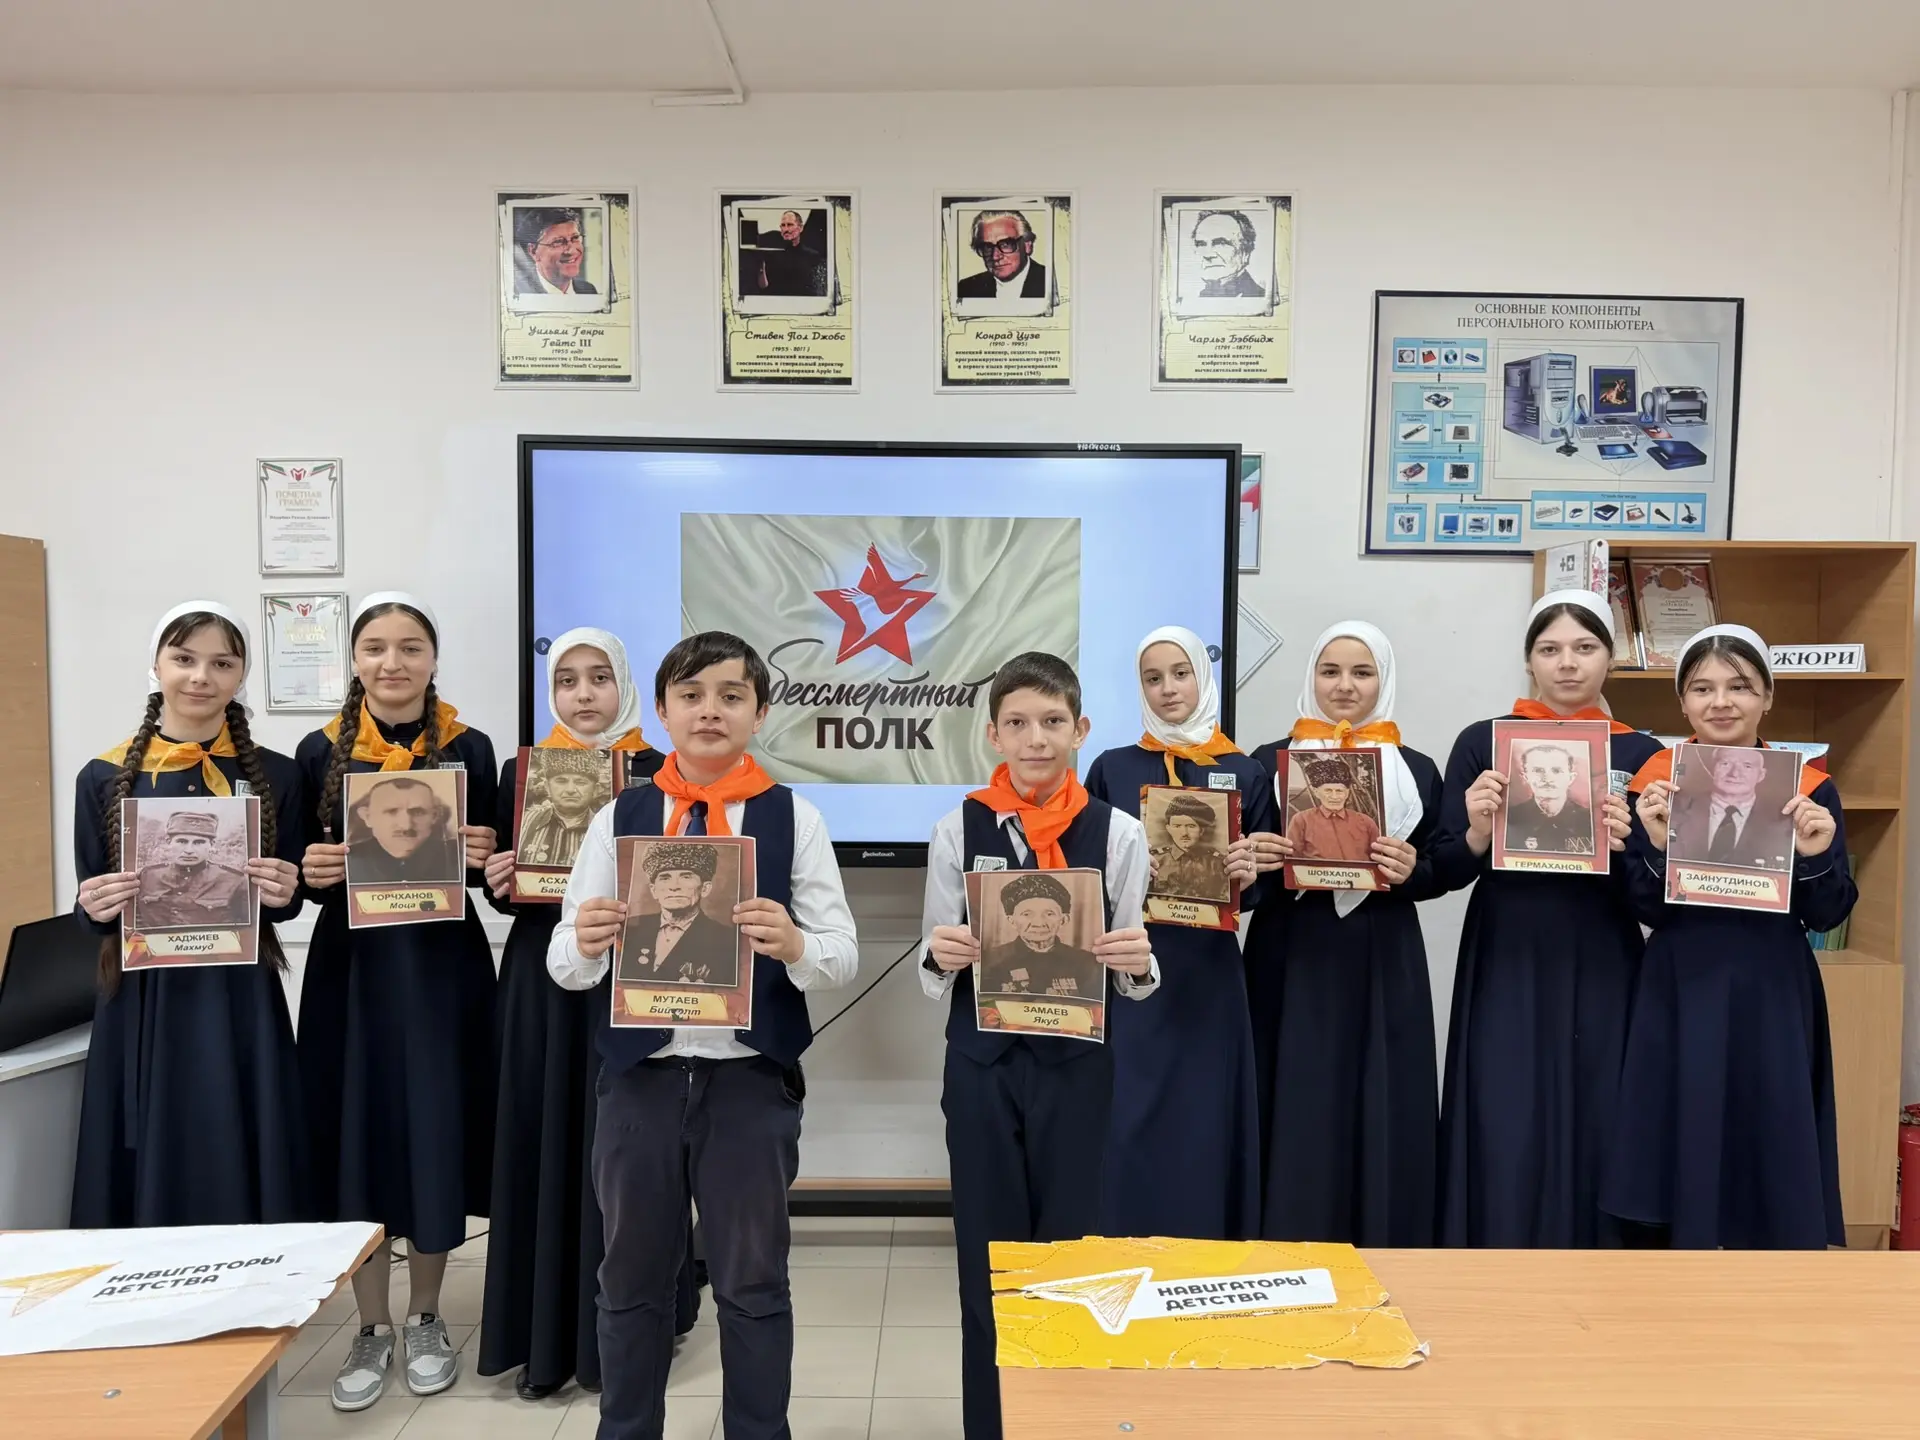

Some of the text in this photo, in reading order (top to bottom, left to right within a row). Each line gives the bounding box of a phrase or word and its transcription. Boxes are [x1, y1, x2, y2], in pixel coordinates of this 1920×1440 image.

[1475, 304, 1641, 317] ОСНОВНЫЕ КОМПОНЕНТЫ
[1457, 316, 1655, 331] ПЕРСОНАЛЬНОГО КОМПЬЮТЕРА
[528, 326, 604, 338] Уильям Генри
[745, 331, 846, 341] Стивен Пол Джобс
[975, 331, 1040, 341] Конрад Цузе
[542, 338, 592, 348] Гейтс III
[1188, 334, 1274, 344] Чарльз Бэббидж
[1773, 652, 1854, 665] ЖЮРИ
[816, 717, 934, 750] ПОЛК
[1515, 861, 1583, 871] ГЕРМАХАНОВ
[1308, 870, 1360, 878] ШОВХАЛОВ
[1686, 873, 1770, 888] ЗАЙНУТДИНОВ
[1698, 884, 1756, 896] Абдуразак
[371, 892, 433, 901] ГОРЧХАНОВ
[1168, 903, 1199, 912] САГАЕВ
[1171, 912, 1196, 920] Хамид
[168, 934, 219, 943] ХАДЖИЕВ
[653, 995, 699, 1005] МУТАЕВ
[1023, 1006, 1068, 1016] ЗАМАЕВ
[1033, 1017, 1060, 1026] Якуб
[106, 1254, 284, 1284] НАВИГАТОРЫ
[92, 1274, 219, 1298] ДЕТСТВА
[1157, 1276, 1307, 1296] НАВИГАТОРЫ
[1166, 1292, 1269, 1311] ДЕТСТВА
